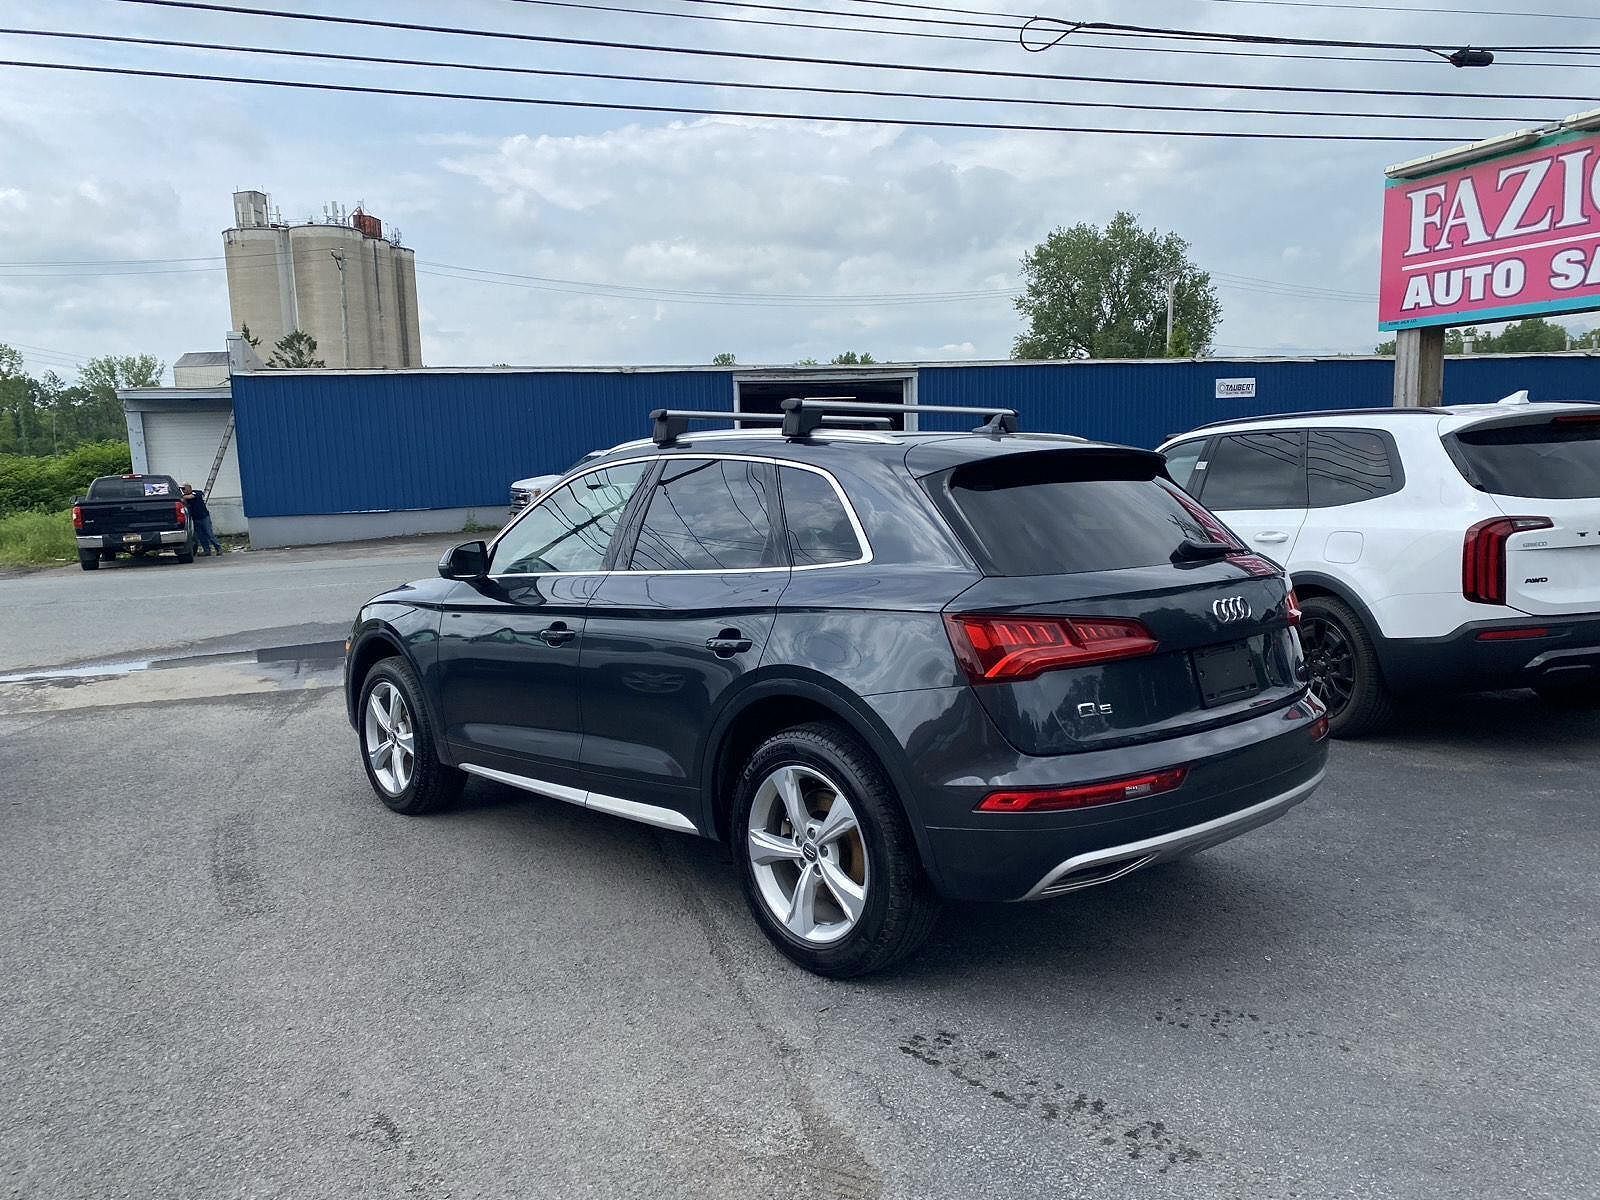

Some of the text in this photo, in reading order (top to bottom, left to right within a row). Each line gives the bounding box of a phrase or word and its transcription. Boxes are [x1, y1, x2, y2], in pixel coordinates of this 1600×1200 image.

[1402, 146, 1600, 257] FAZI
[1400, 257, 1527, 312] AUTO
[1077, 702, 1113, 718] Q5
